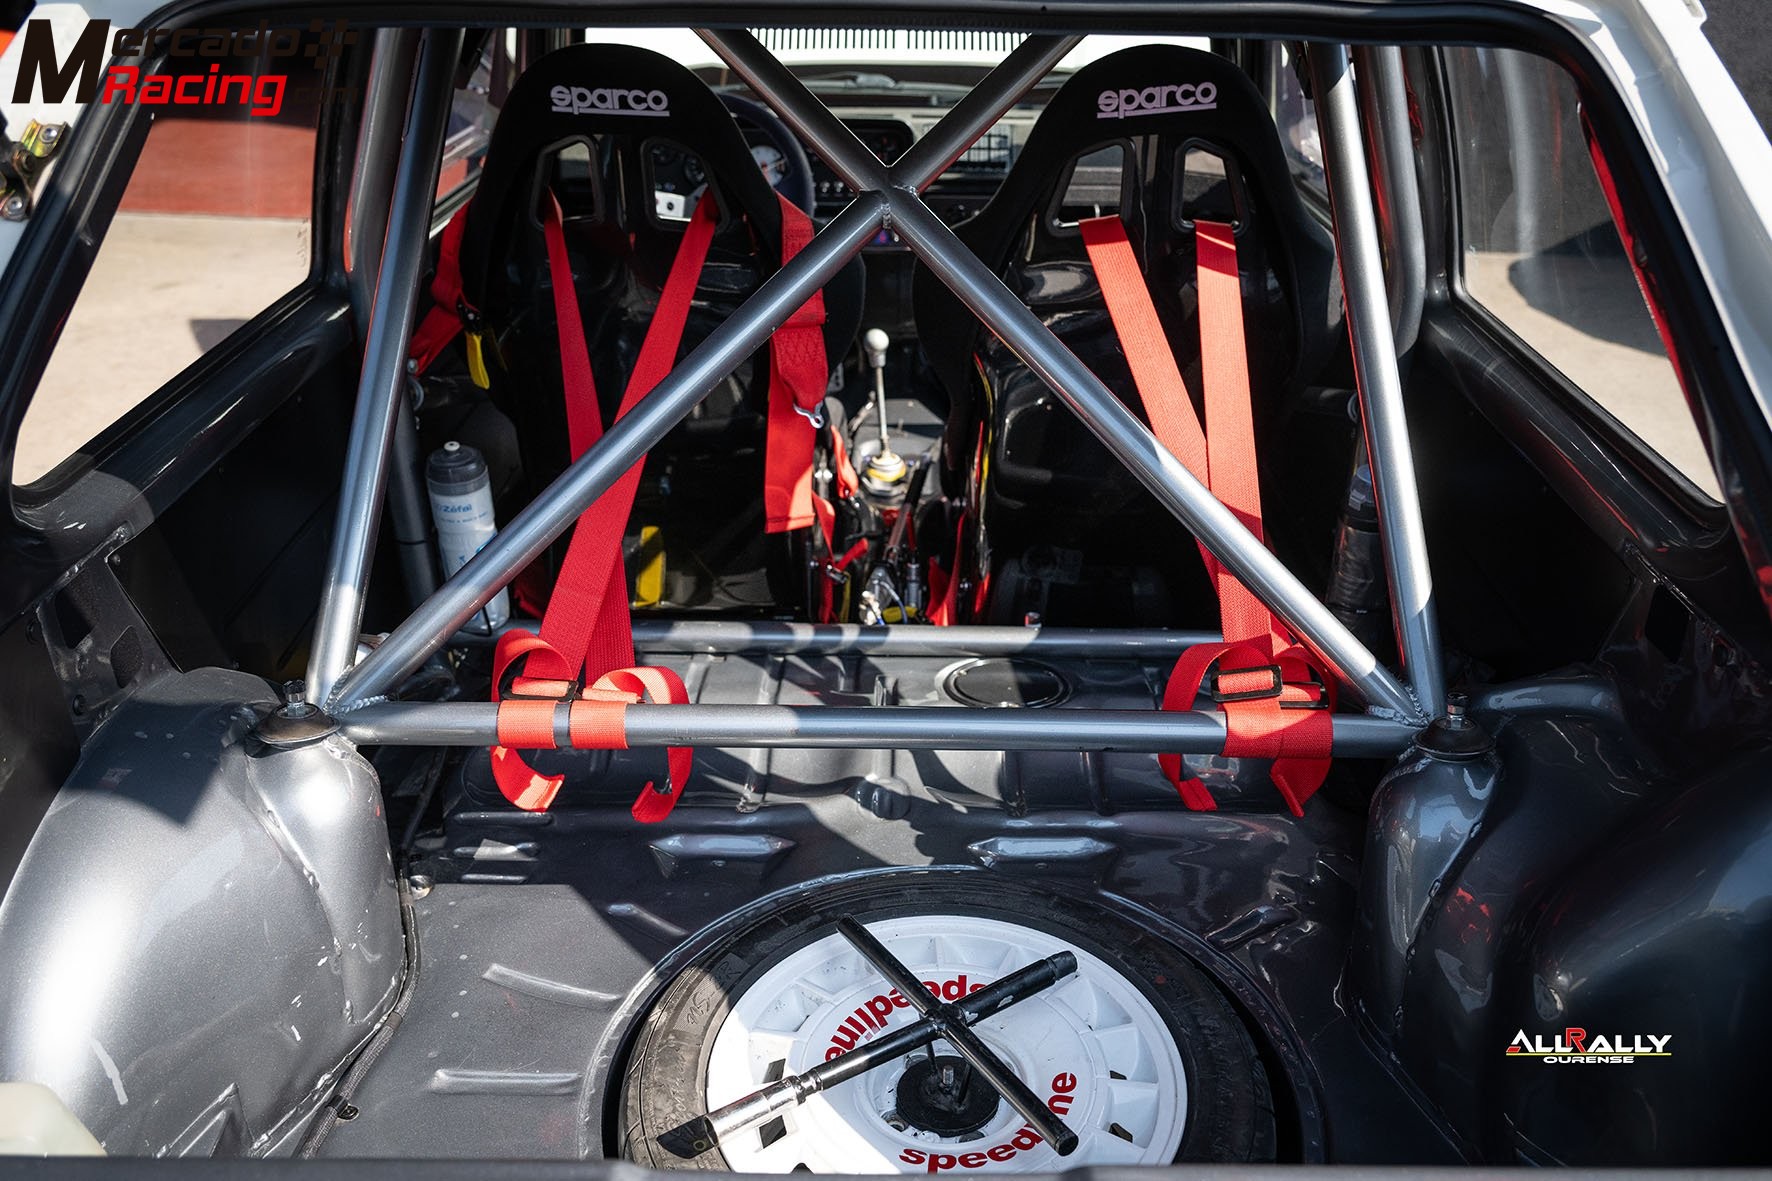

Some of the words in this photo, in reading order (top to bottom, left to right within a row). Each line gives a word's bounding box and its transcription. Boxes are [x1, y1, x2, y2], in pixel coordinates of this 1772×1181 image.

[551, 85, 669, 115] sparco
[1097, 82, 1217, 119] sparco
[899, 1072, 1077, 1174] speedne
